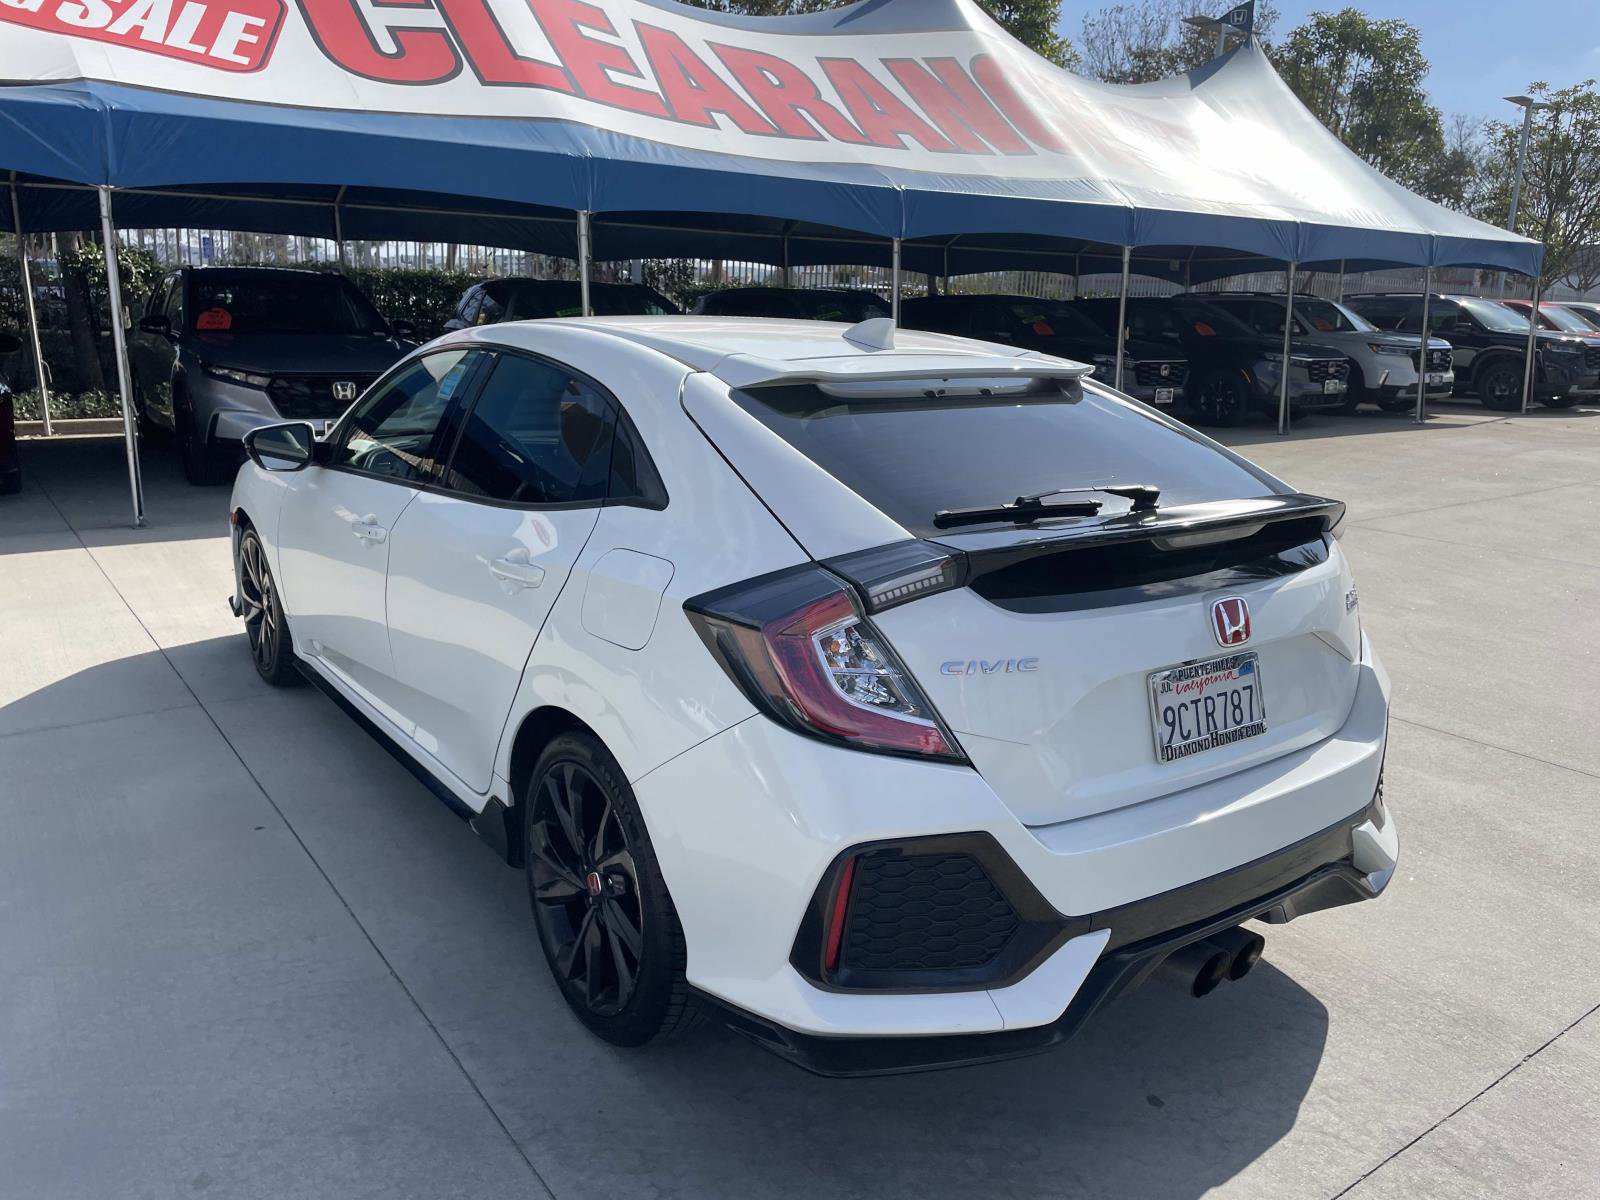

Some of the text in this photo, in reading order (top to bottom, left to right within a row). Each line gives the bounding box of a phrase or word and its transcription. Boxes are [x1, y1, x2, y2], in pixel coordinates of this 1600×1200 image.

[302, 0, 1180, 162] CLEARAN
[1217, 598, 1248, 645] H
[940, 657, 1040, 675] CIVIC
[1178, 662, 1211, 682] PUENTE
[1160, 682, 1173, 694] JUL
[1175, 671, 1239, 695] California
[1163, 684, 1253, 745] 9CTR787
